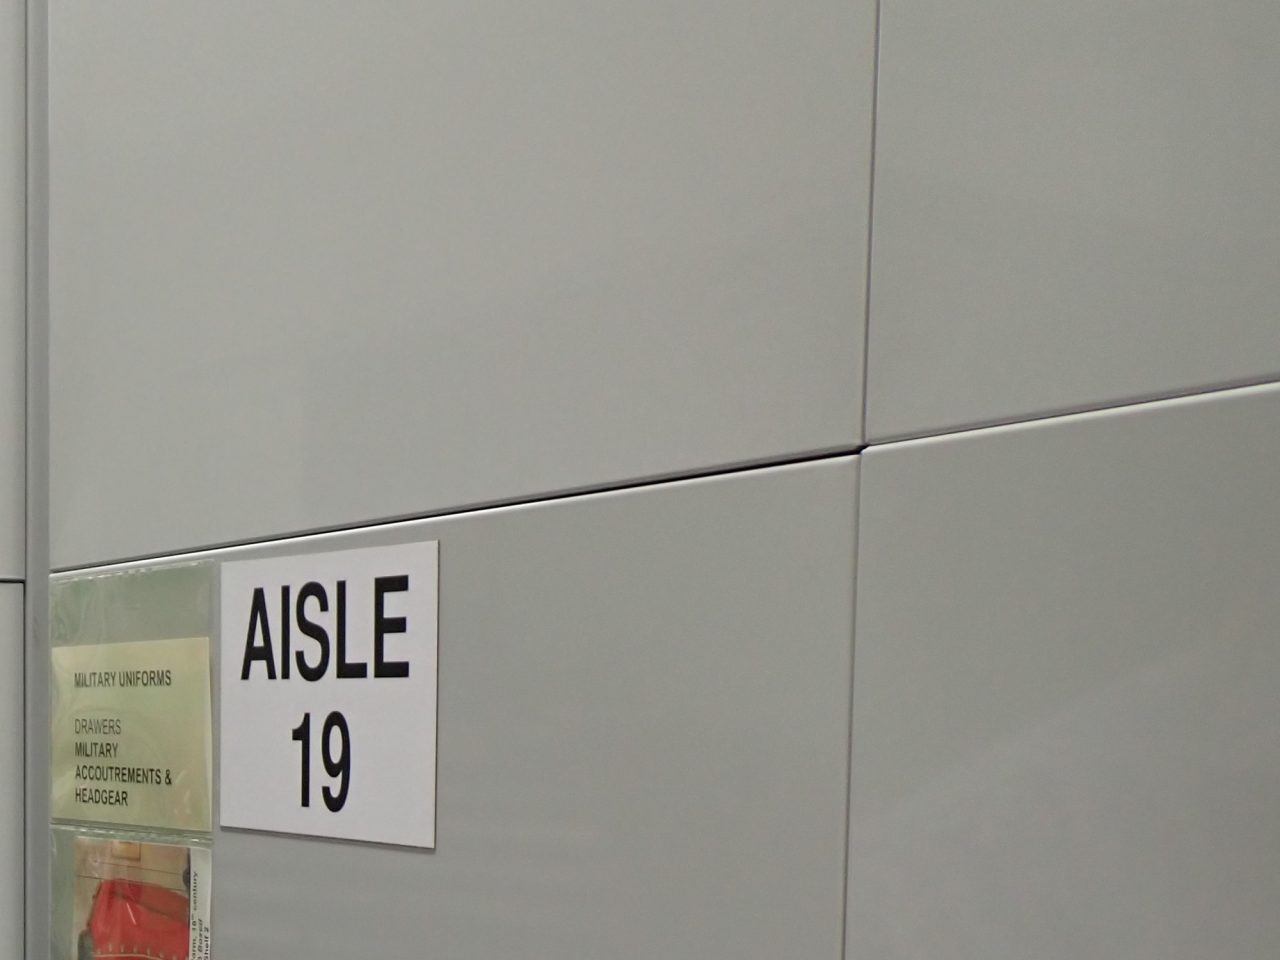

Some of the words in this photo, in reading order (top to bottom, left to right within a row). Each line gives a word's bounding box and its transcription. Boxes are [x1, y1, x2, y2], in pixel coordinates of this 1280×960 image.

[240, 574, 410, 682] AISLE
[74, 671, 116, 688] MILITARY
[119, 669, 172, 687] UNIFORMS
[74, 718, 122, 735] DRAWERS
[74, 742, 119, 758] MILITARY
[291, 710, 351, 813] 19
[75, 764, 162, 785] ACCOUTREMENTS
[164, 769, 172, 785] &
[75, 787, 129, 807] HEADGEAR
